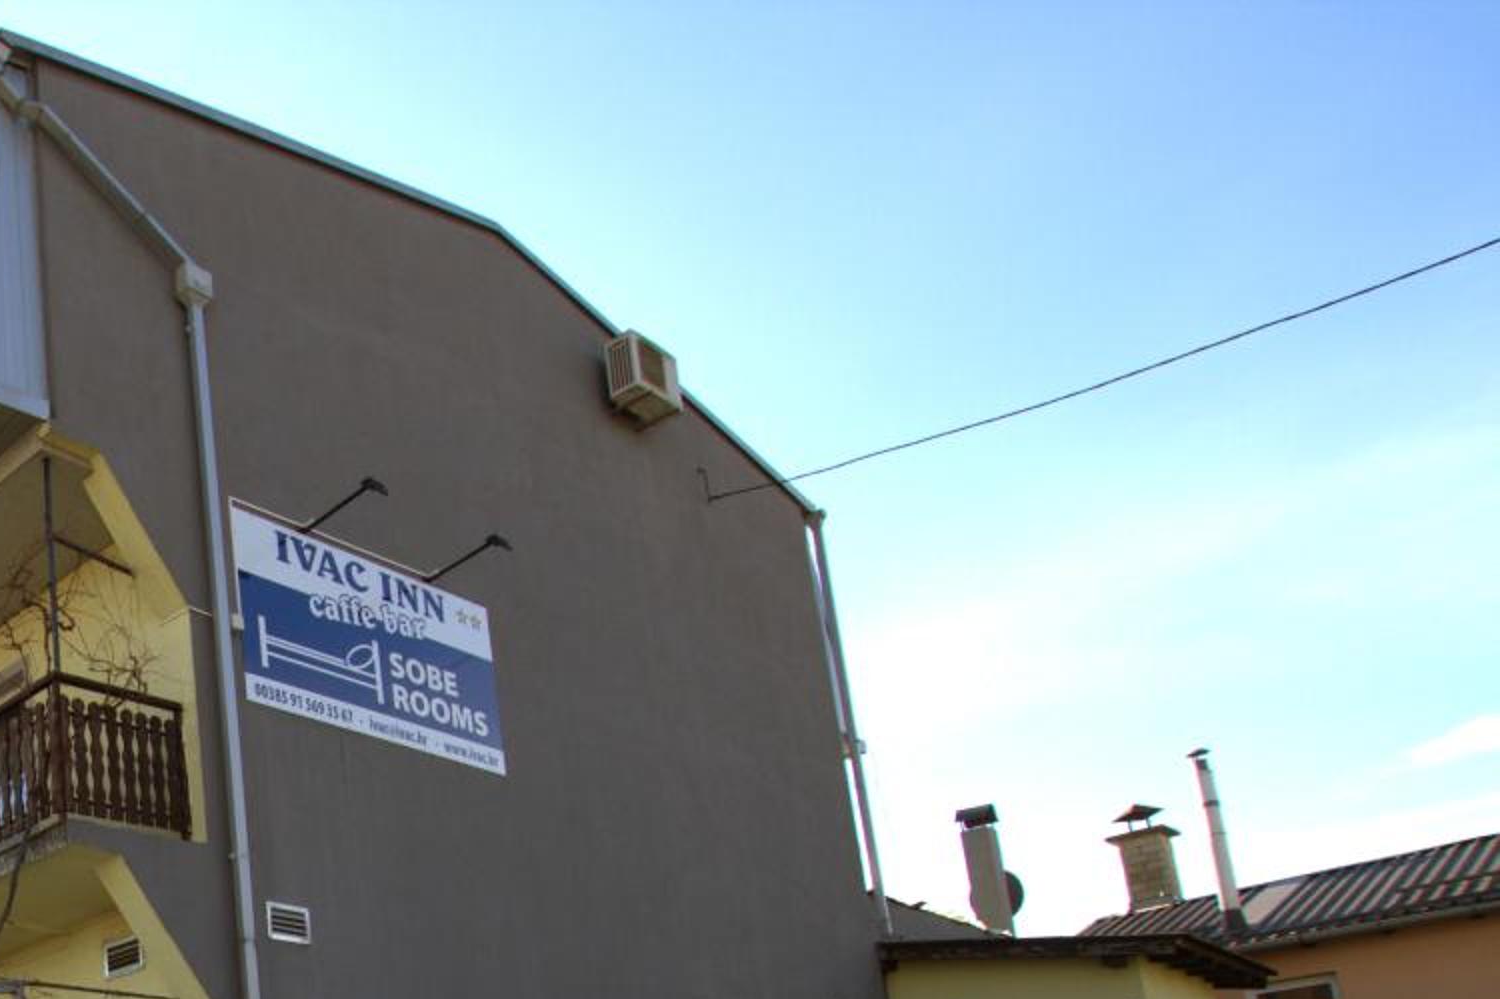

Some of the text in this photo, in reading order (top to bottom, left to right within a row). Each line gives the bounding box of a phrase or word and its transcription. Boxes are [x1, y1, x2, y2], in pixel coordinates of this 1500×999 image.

[274, 530, 445, 623] IVAC INN
[389, 654, 459, 696] SOBE
[392, 684, 490, 737] ROOMS
